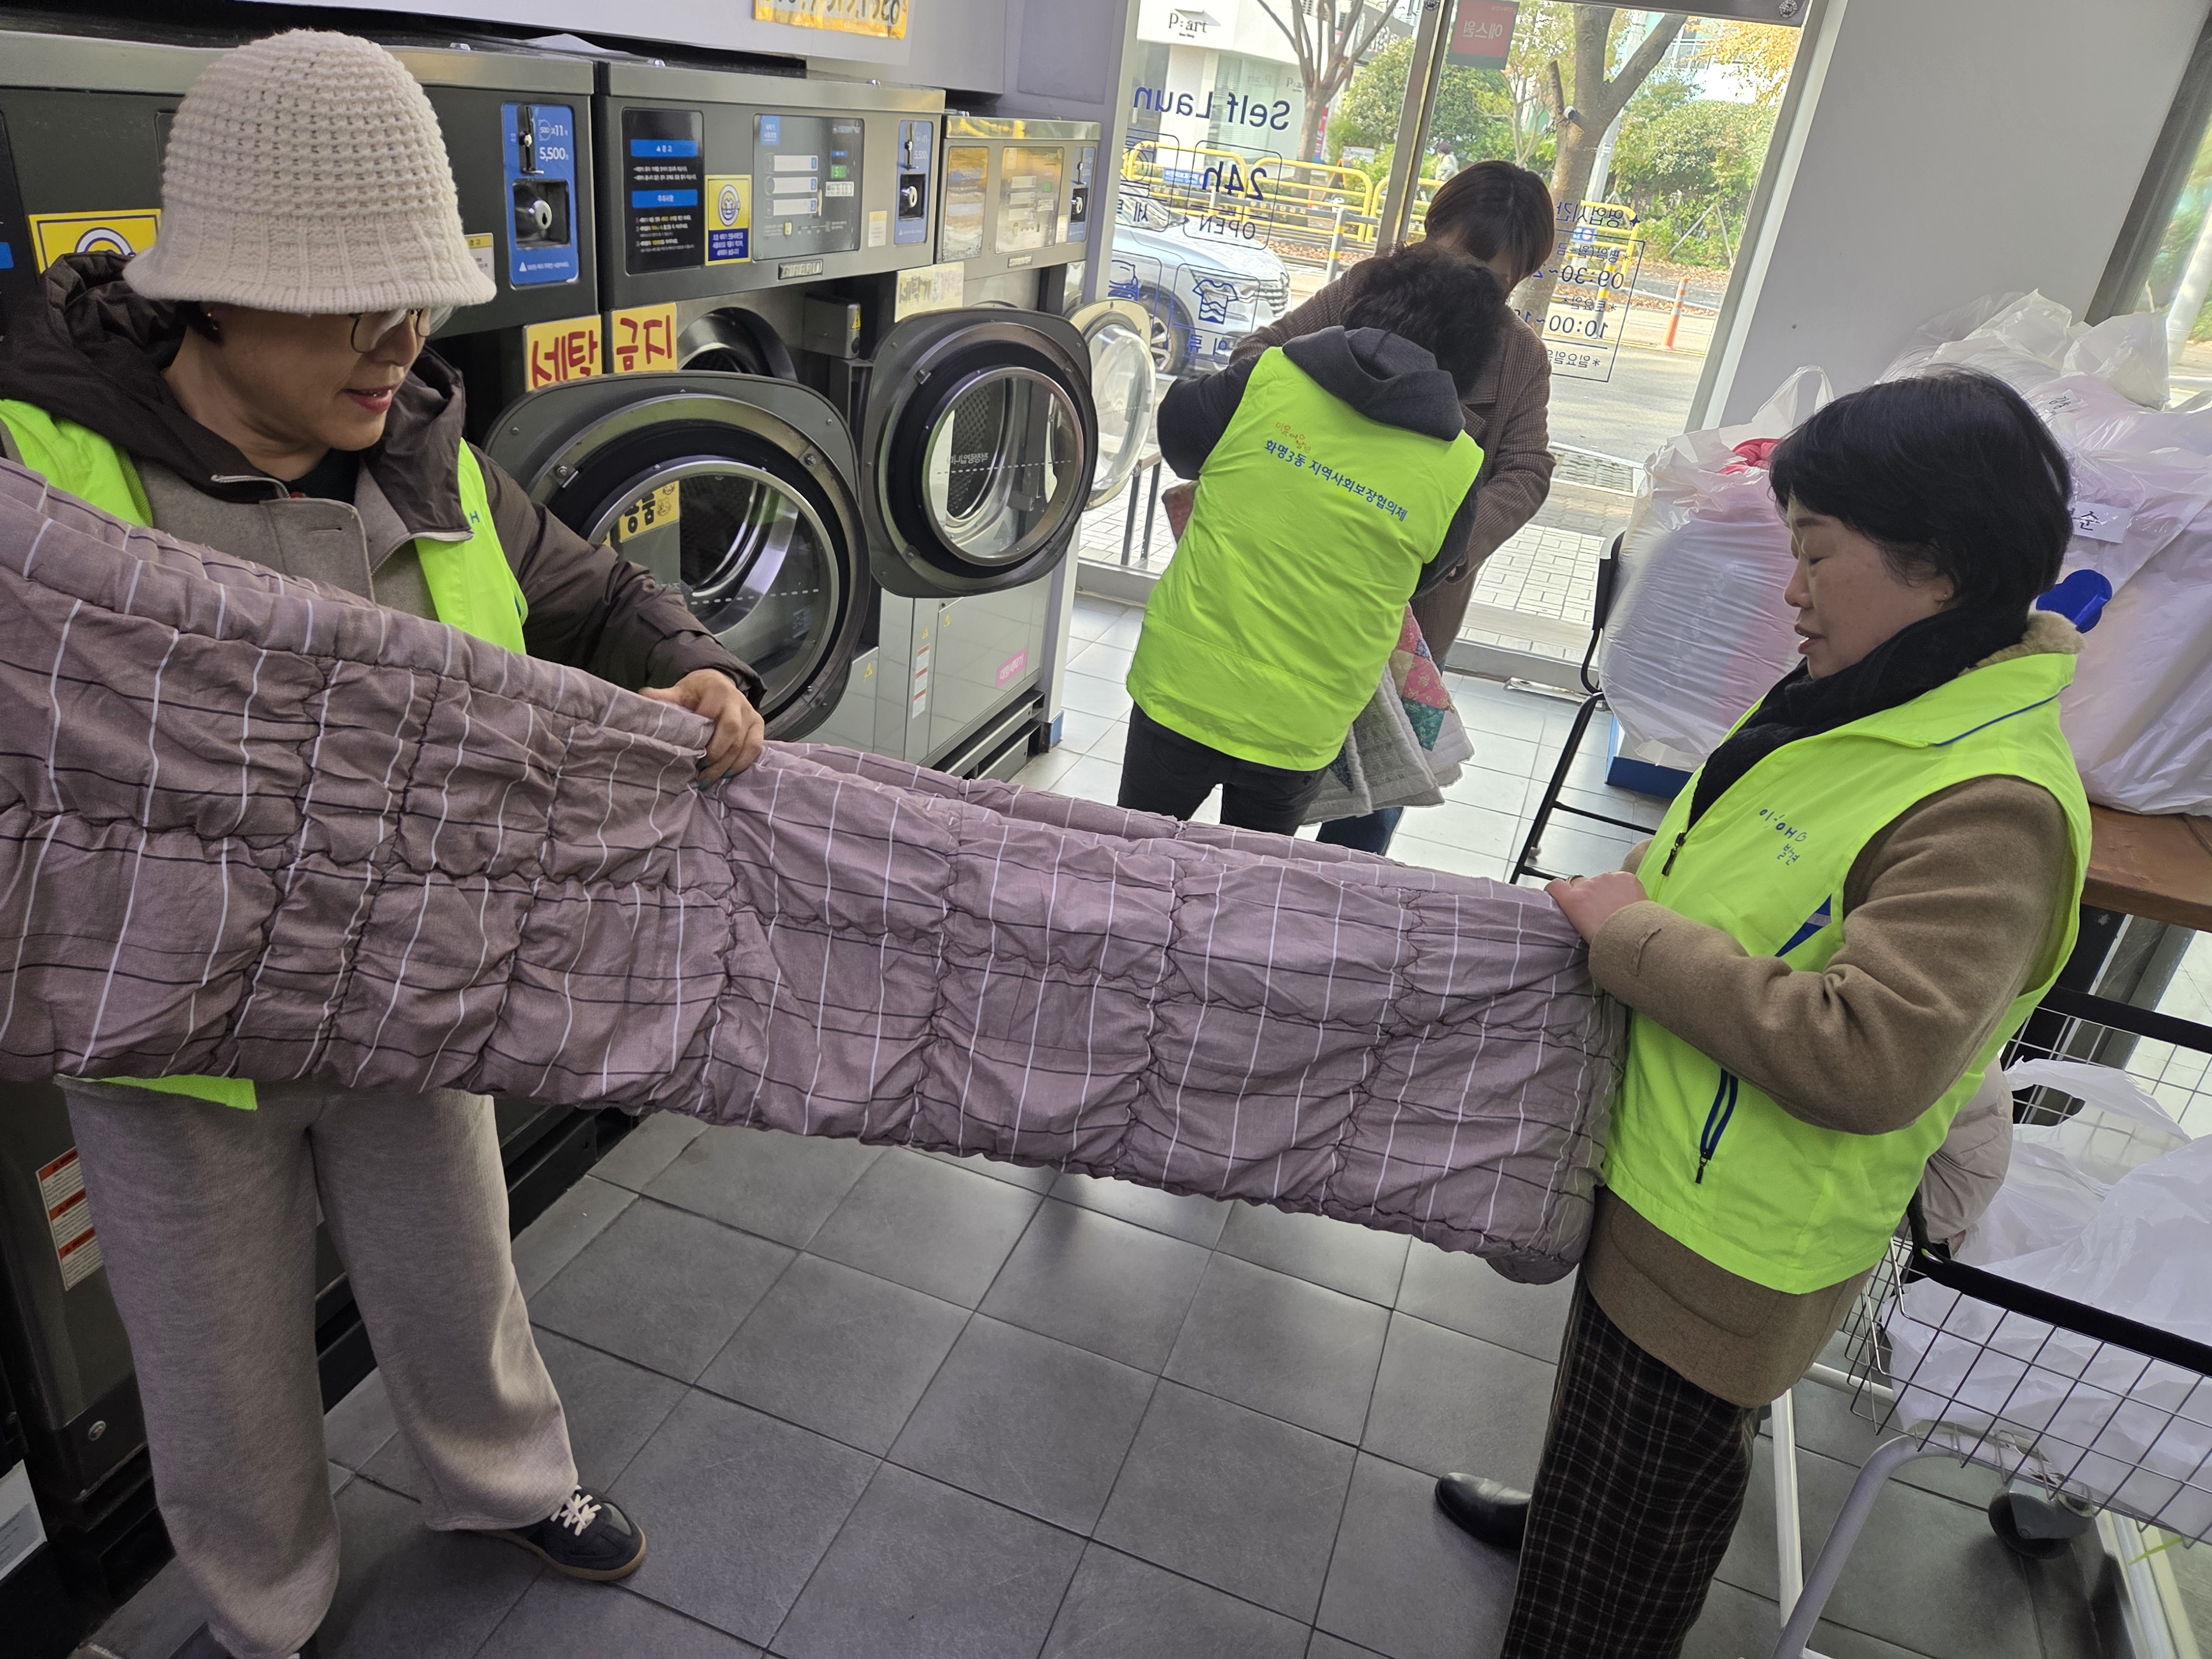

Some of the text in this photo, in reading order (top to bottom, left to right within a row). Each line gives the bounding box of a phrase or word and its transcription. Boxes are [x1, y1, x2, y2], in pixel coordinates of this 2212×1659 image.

[531, 315, 672, 388] 세탁 금지
[1264, 440, 1408, 522] 화명3동 지역사회보장협의체
